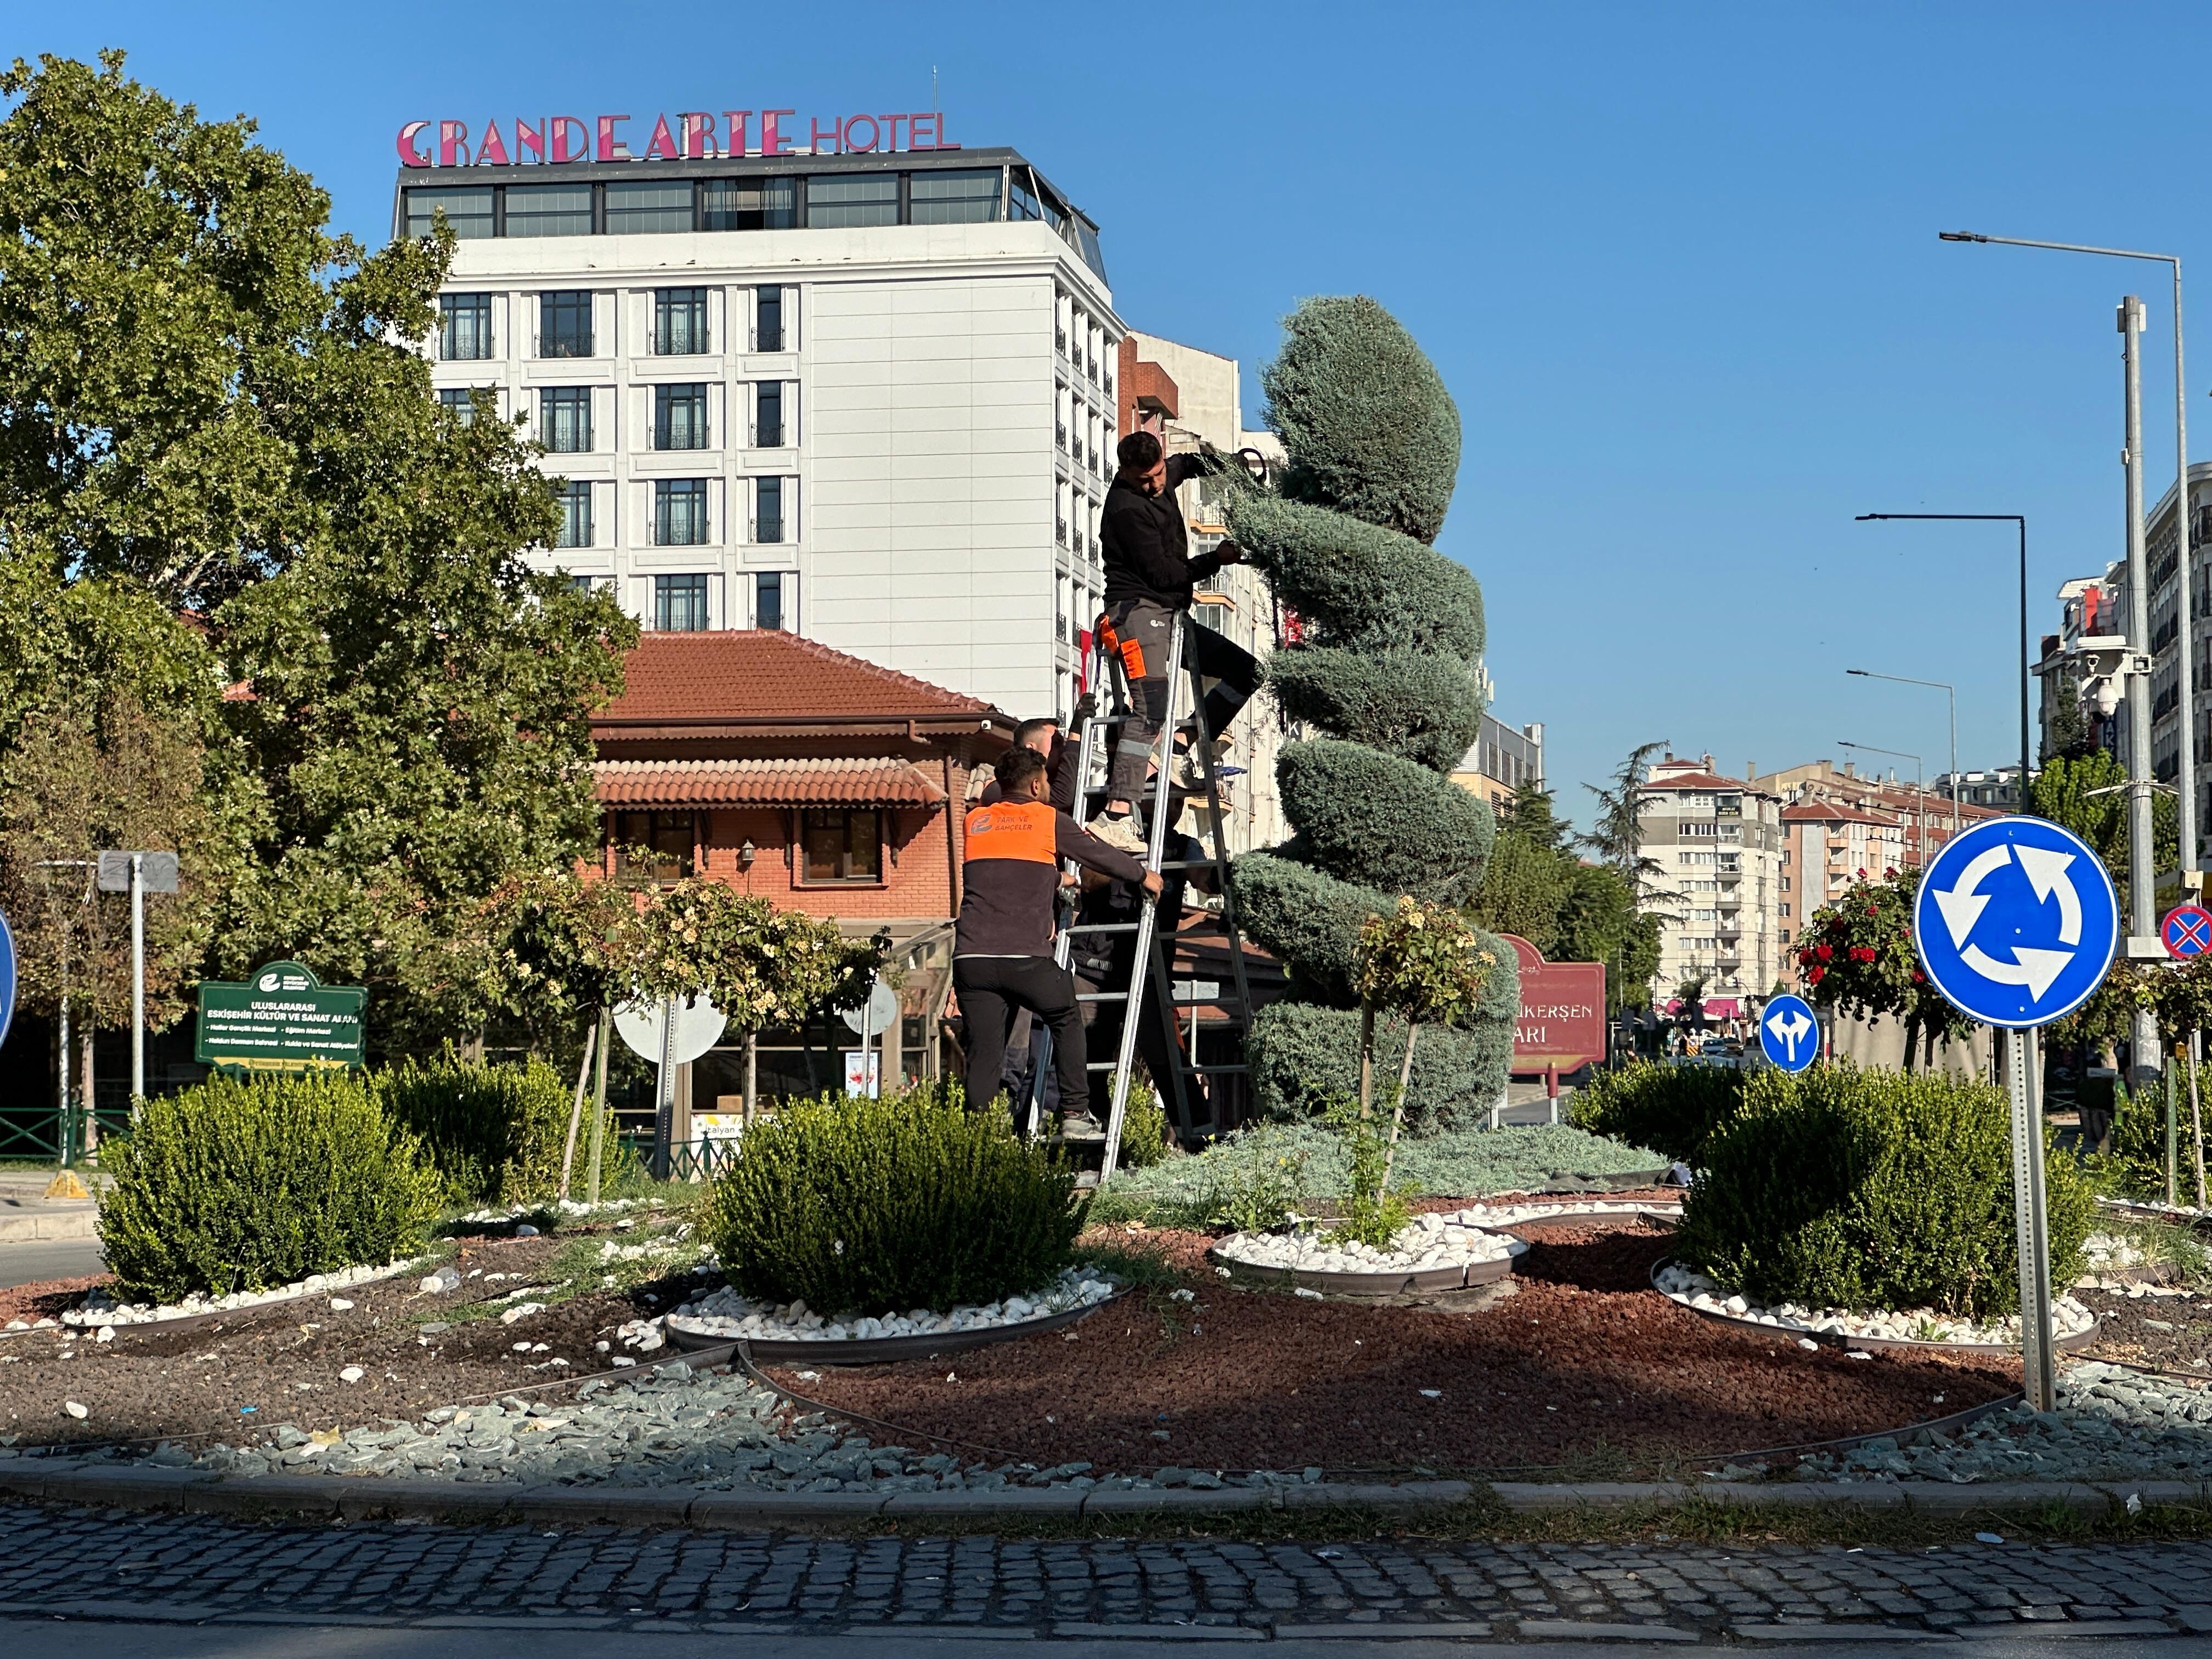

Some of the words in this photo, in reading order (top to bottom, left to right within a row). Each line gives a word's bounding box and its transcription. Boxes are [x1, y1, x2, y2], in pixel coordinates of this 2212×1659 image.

[397, 116, 631, 167] GRANDE
[639, 109, 795, 162] ARTE
[810, 112, 961, 155] HOTEL
[251, 1001, 316, 1012] ULUSLARARASI
[207, 1009, 252, 1019] ESKİŞEHİR
[253, 1011, 286, 1020] KÜLTÜR
[288, 1013, 301, 1021] VE
[301, 1014, 331, 1023] SANAT
